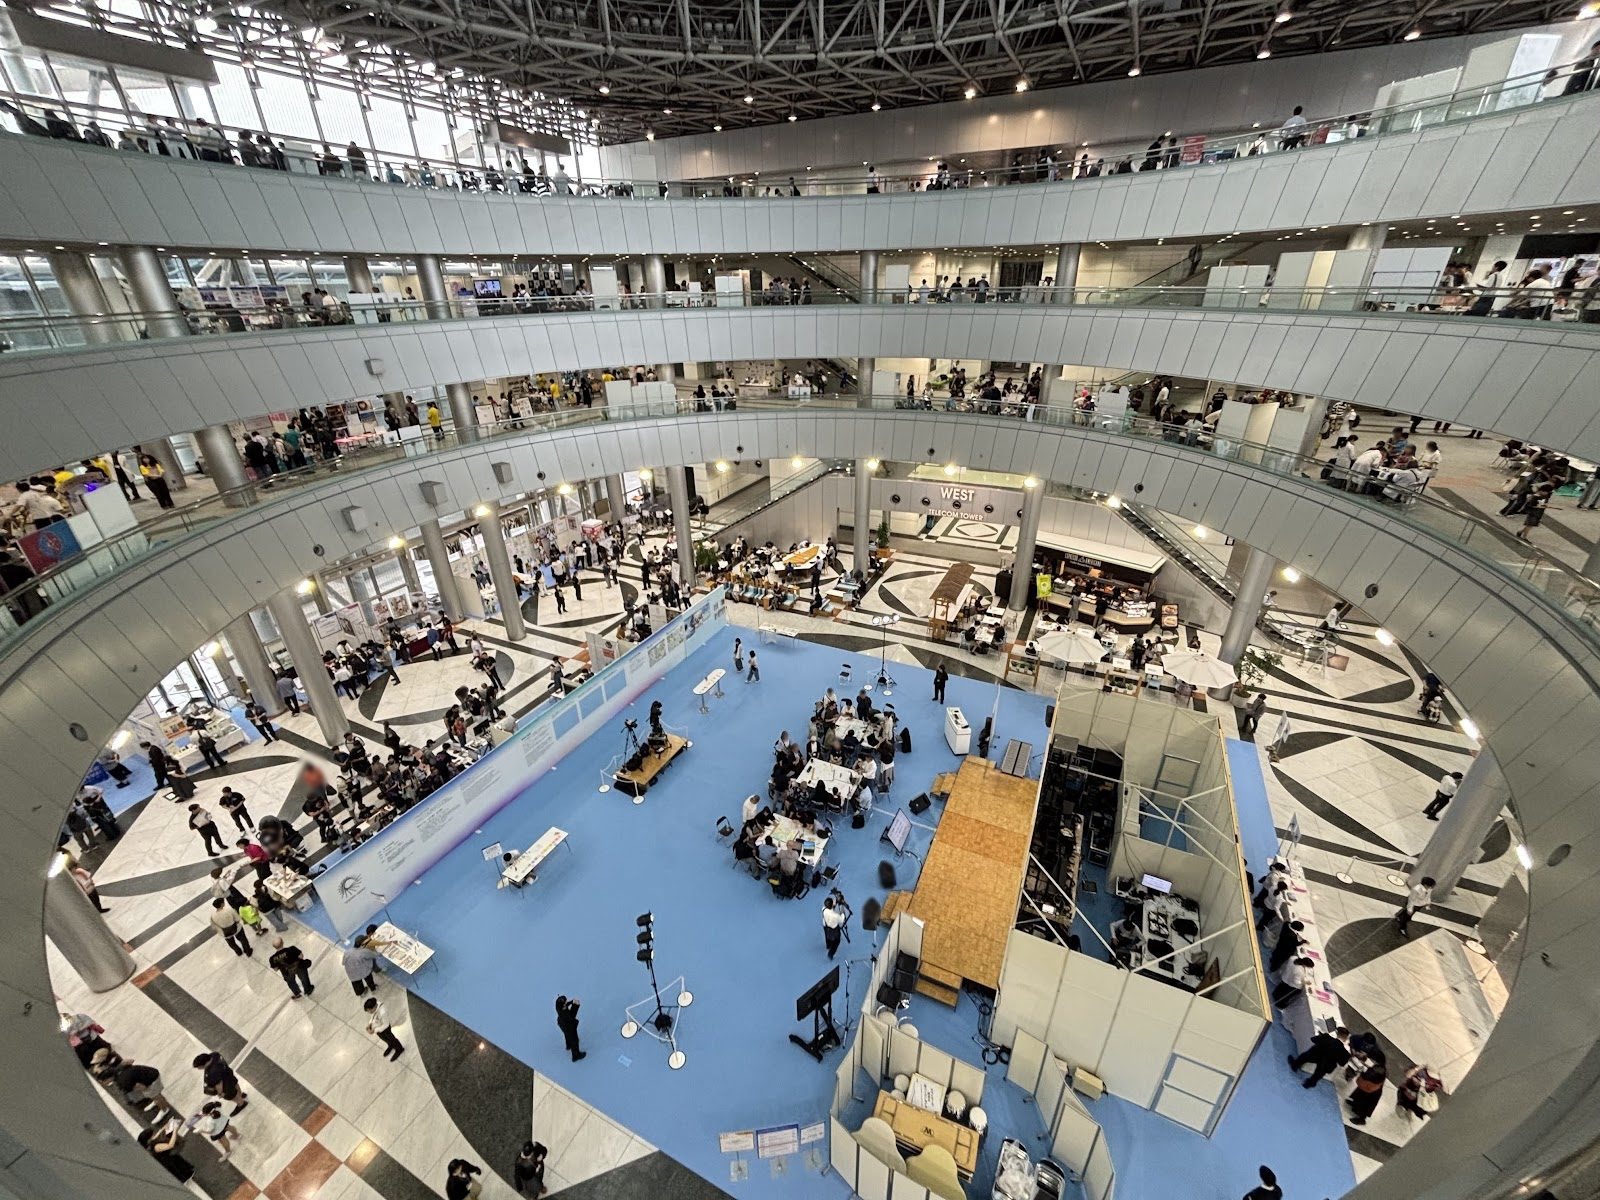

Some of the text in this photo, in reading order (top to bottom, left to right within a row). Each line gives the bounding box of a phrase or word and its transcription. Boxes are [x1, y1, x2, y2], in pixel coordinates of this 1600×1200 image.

[940, 487, 974, 501] WEST
[928, 509, 983, 521] TELECOM TOWER
